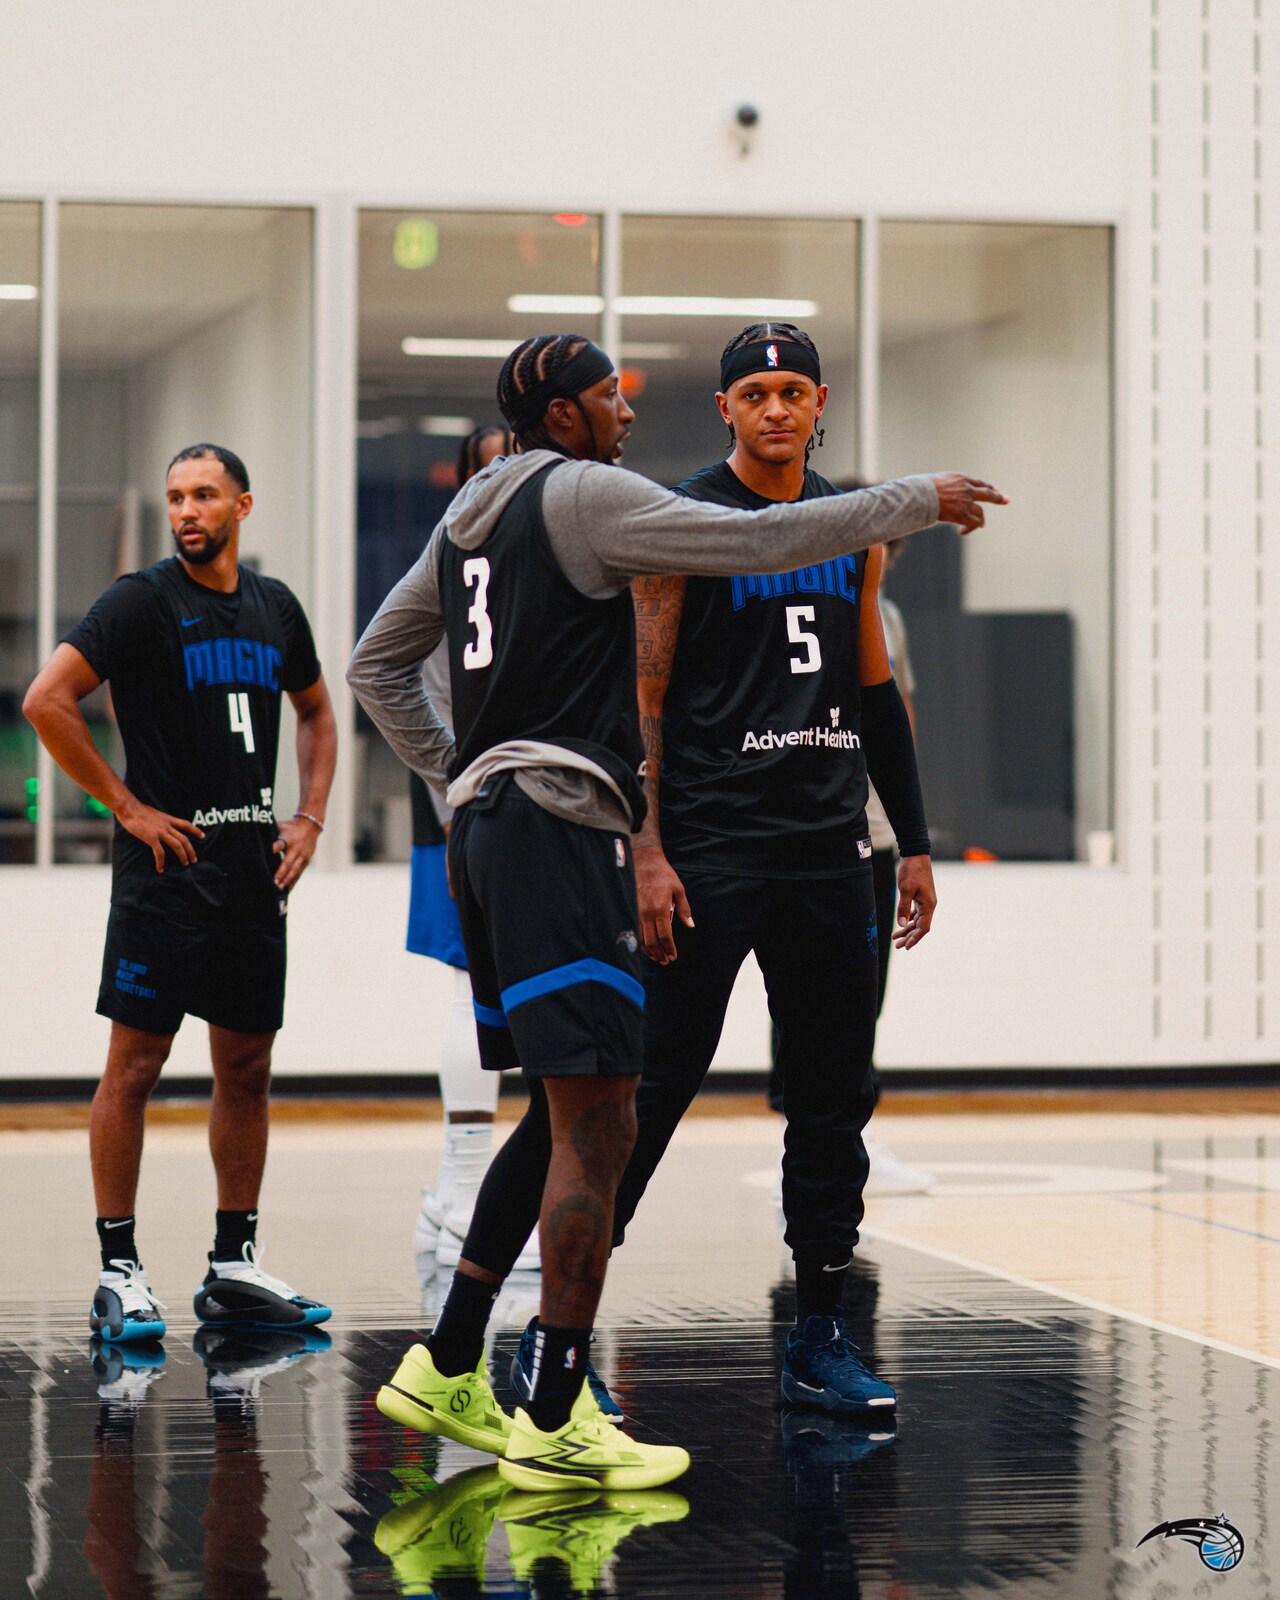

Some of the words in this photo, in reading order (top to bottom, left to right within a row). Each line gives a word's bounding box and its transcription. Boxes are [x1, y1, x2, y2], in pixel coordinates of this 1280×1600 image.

[463, 556, 493, 671] 3
[785, 605, 822, 674] 5
[183, 637, 282, 695] MAGIC
[228, 692, 256, 753] 4
[741, 726, 861, 752] AdventHealth
